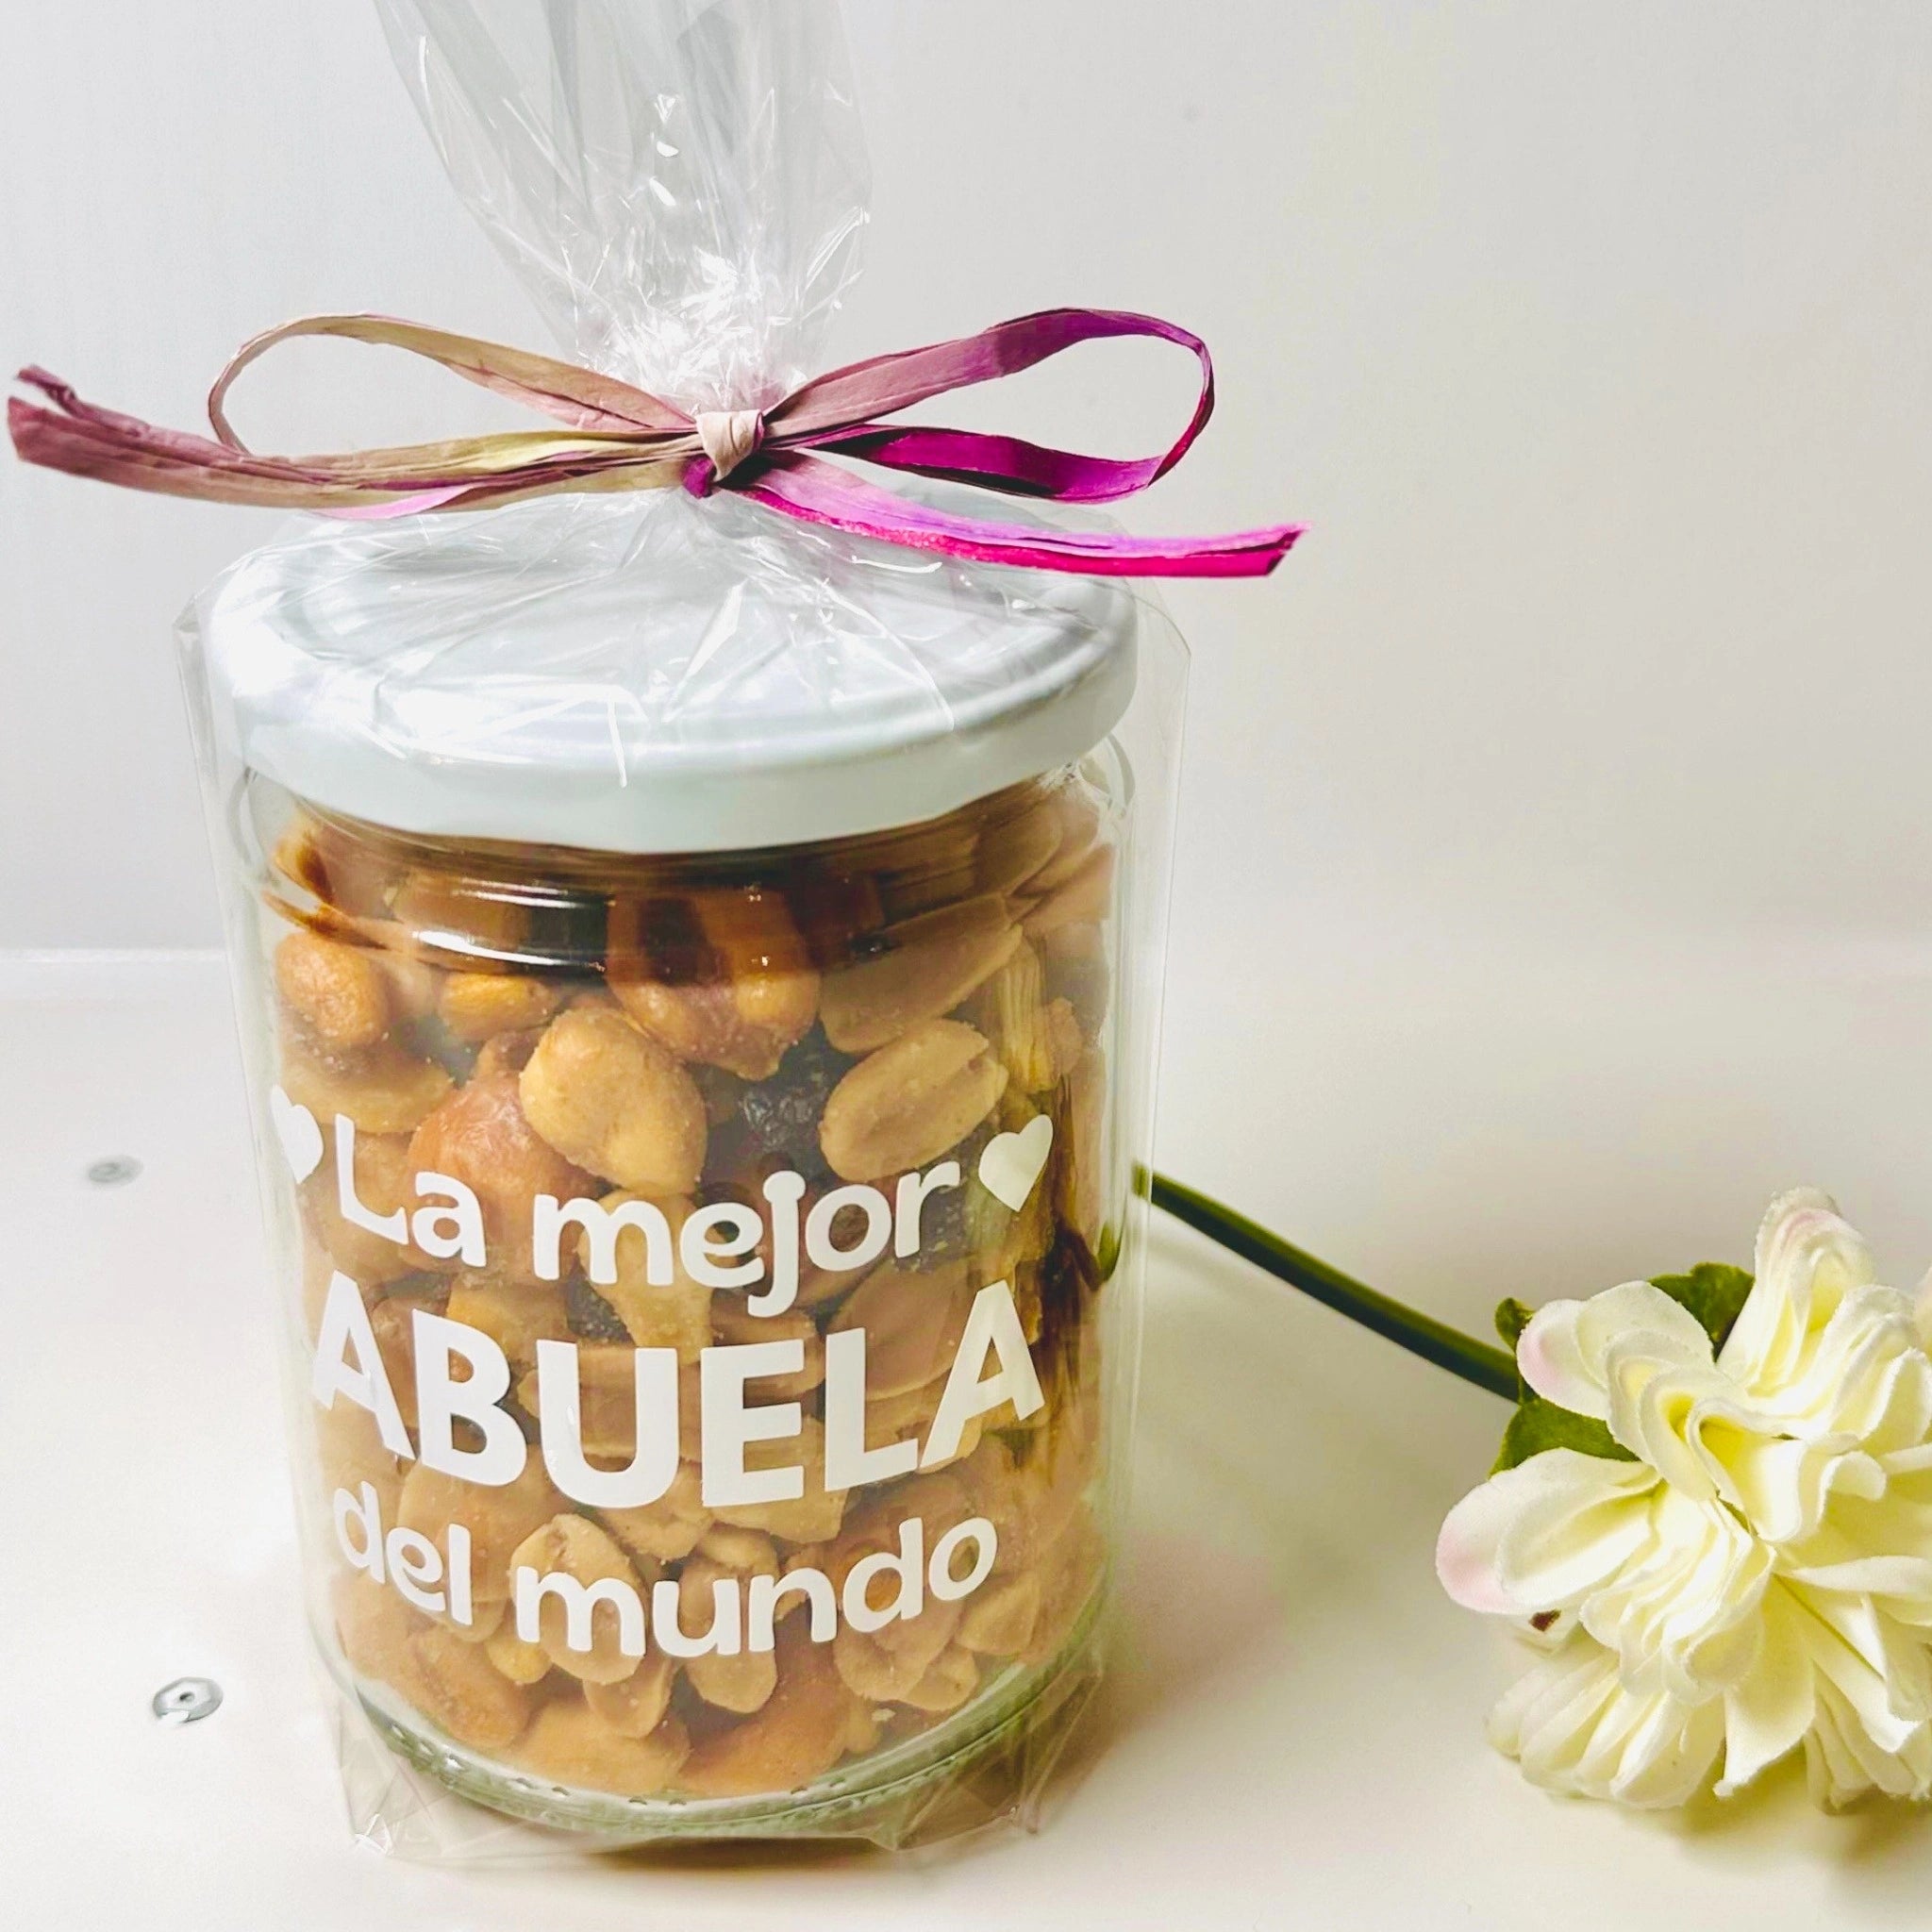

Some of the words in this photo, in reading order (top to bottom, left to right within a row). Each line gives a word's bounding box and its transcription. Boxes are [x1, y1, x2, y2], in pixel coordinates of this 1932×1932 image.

[335, 1113, 487, 1268] La
[533, 1160, 961, 1318] mejor
[312, 1269, 1046, 1509] ABUELA
[333, 1480, 474, 1626] del
[515, 1517, 998, 1658] mundo
